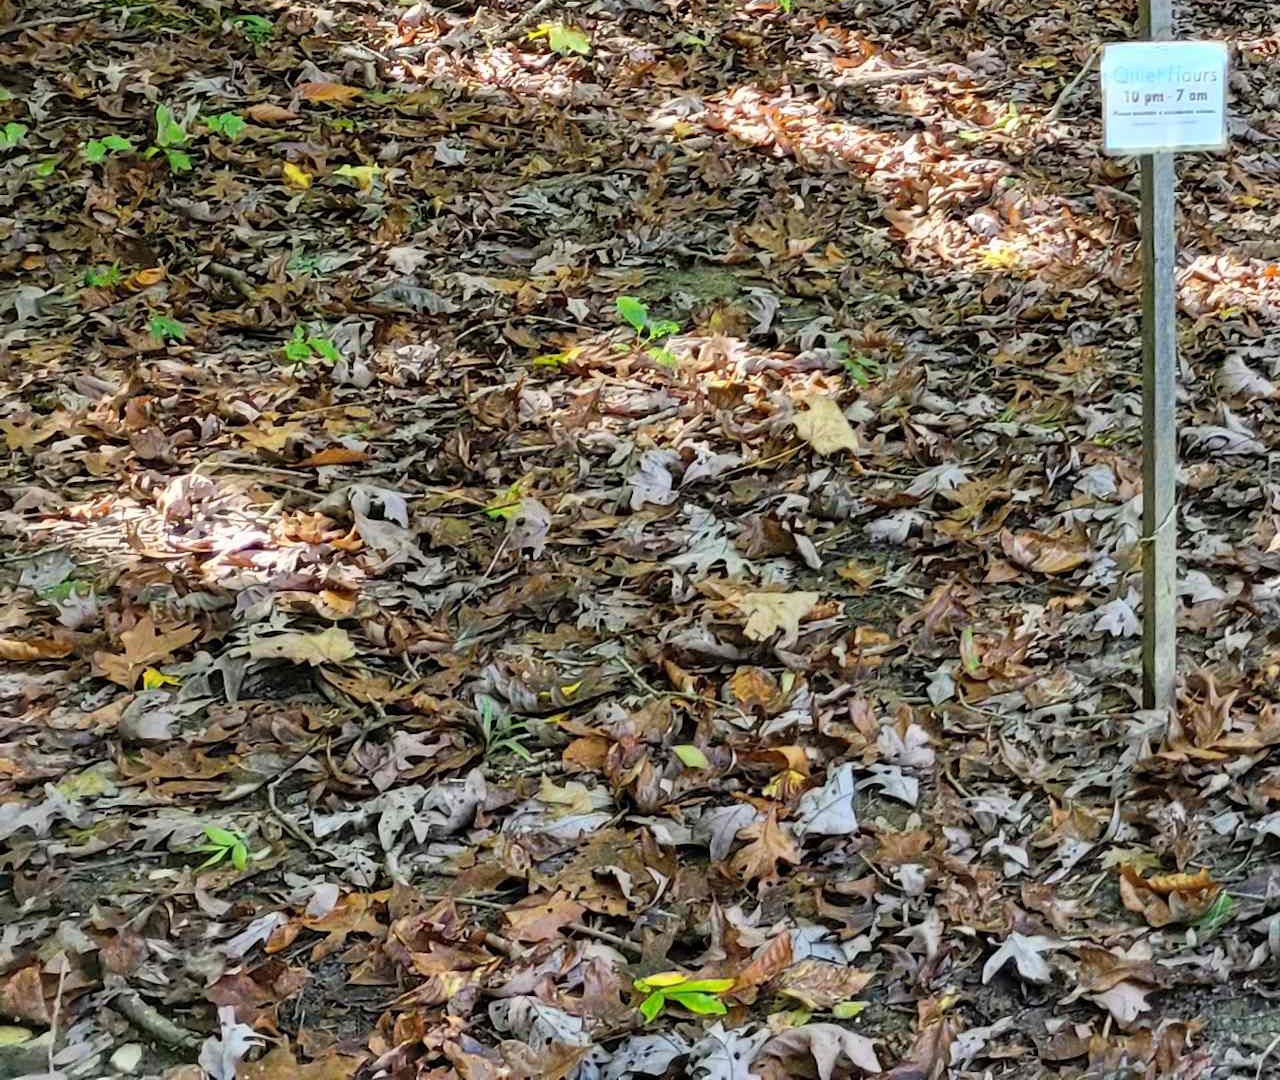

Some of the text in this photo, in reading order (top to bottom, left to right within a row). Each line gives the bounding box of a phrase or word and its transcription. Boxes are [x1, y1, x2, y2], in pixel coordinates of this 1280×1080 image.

[1168, 64, 1217, 82] Hours
[1125, 90, 1140, 103] 10
[1144, 92, 1164, 106] pm
[1176, 88, 1185, 101] 7
[1189, 91, 1208, 102] am
